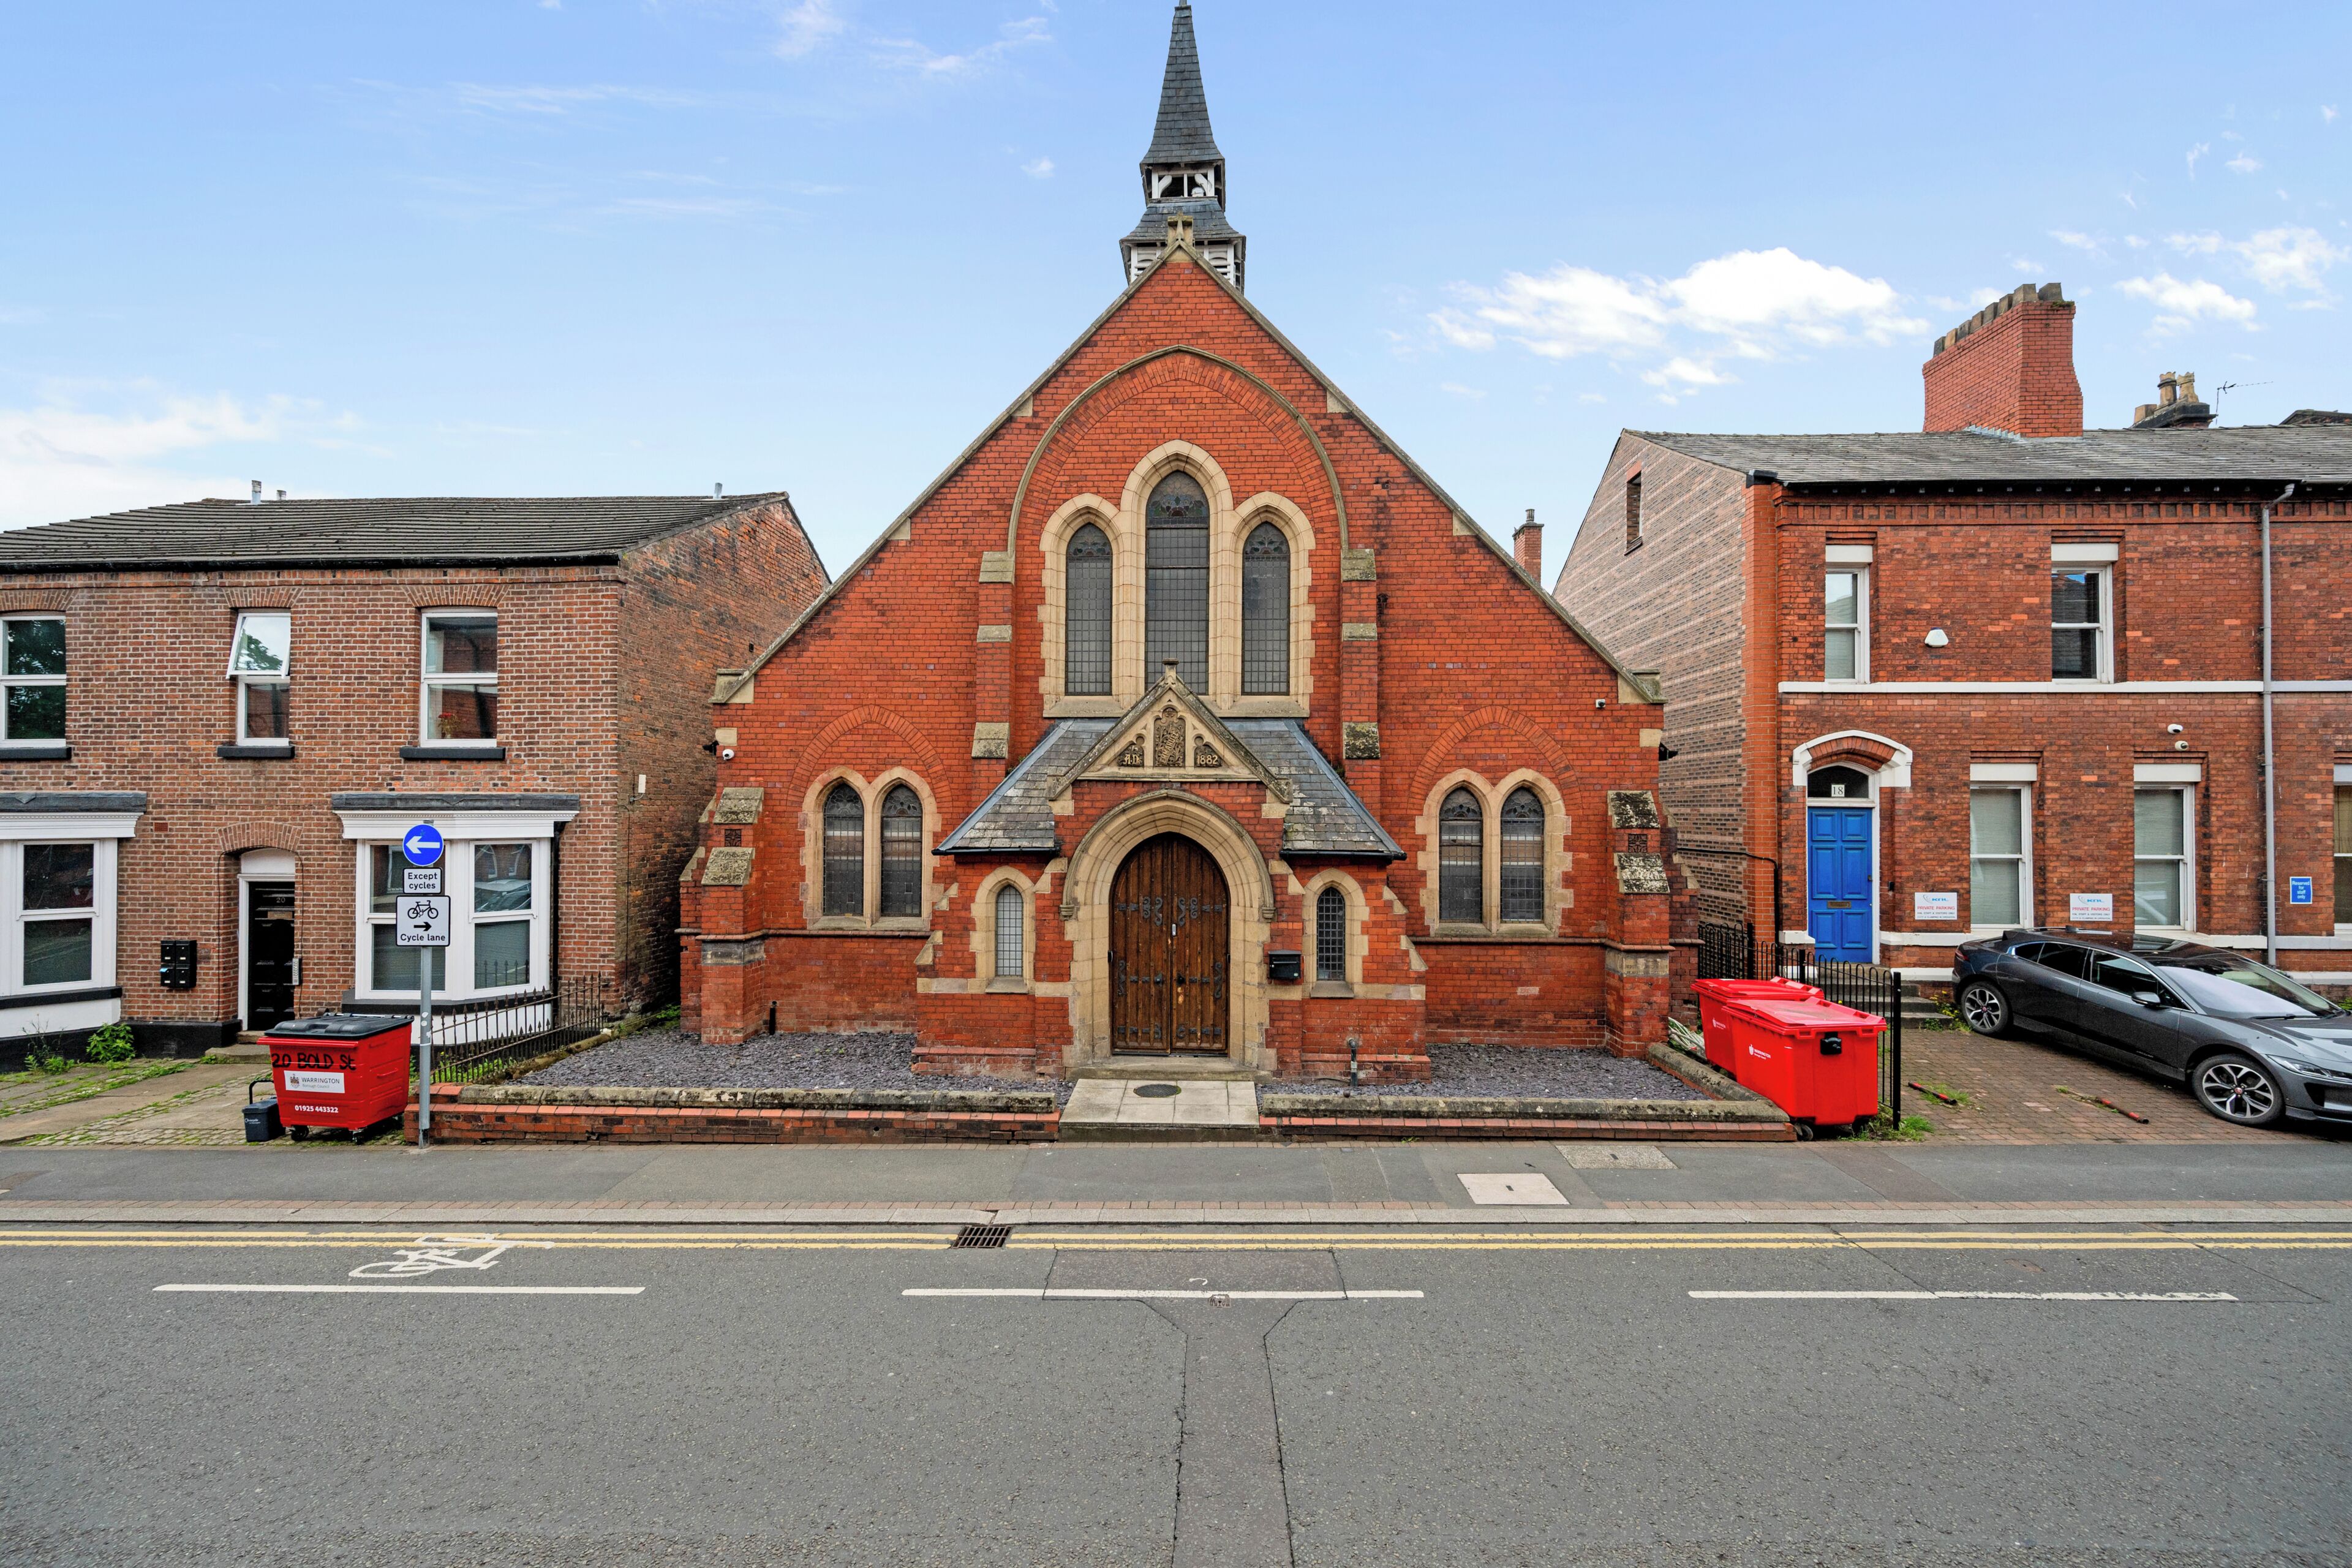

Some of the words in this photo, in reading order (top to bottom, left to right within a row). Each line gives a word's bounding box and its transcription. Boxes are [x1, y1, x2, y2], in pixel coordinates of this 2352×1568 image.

[1160, 730, 1178, 763] EMMANUEL
[1197, 755, 1218, 764] 1882
[401, 933, 424, 942] Cycle
[271, 1054, 292, 1068] 20
[297, 1053, 334, 1069] BOLD
[339, 1054, 356, 1070] St
